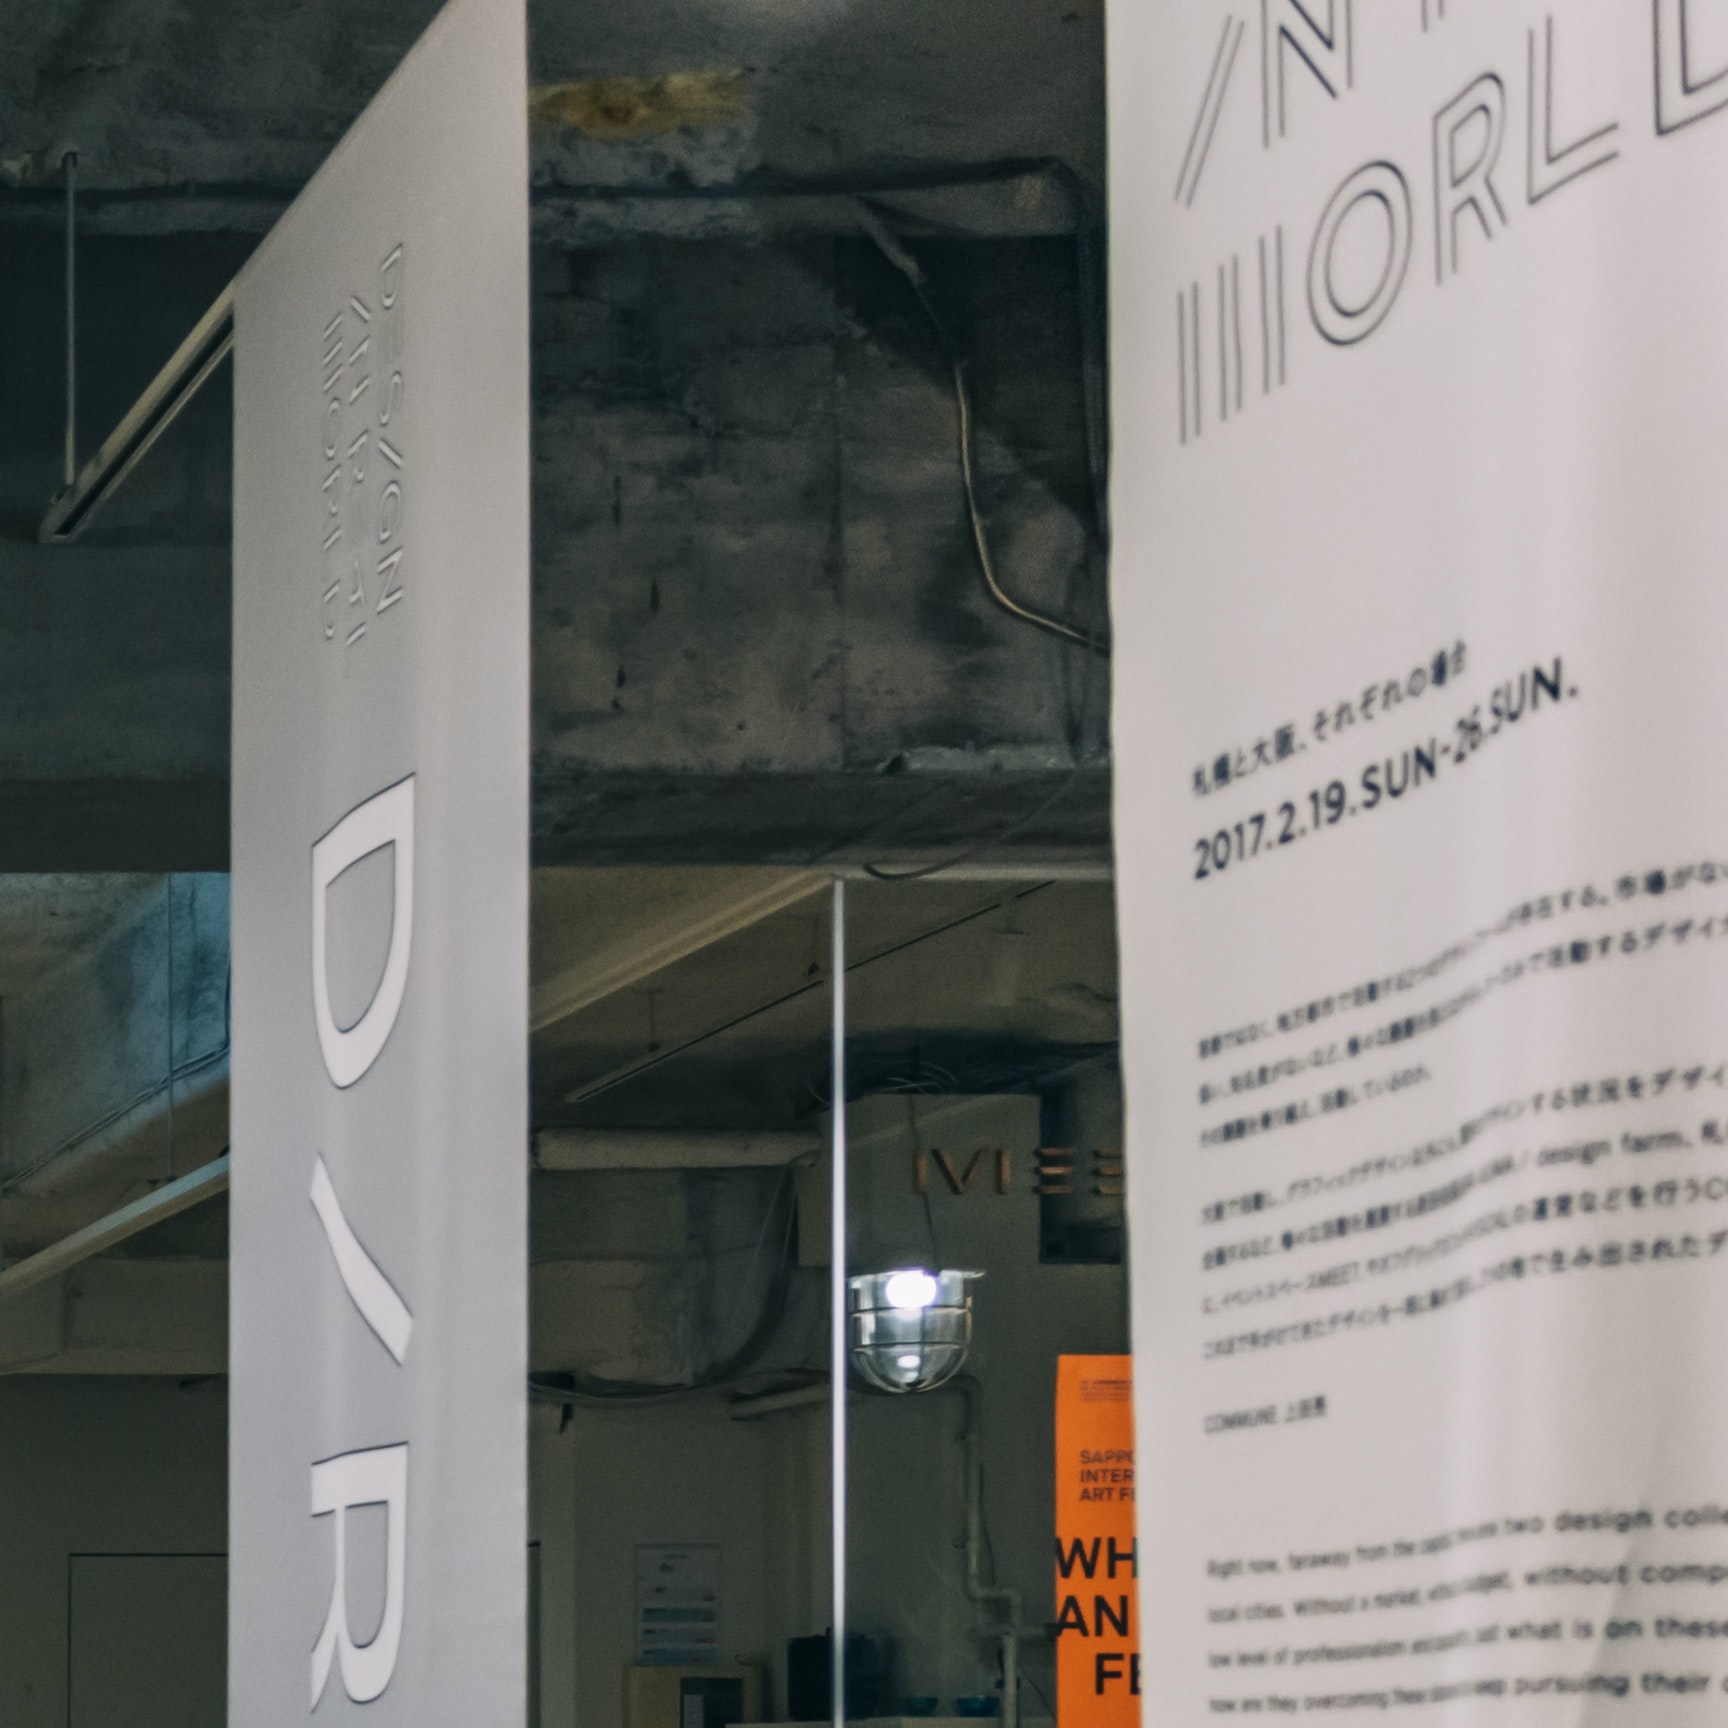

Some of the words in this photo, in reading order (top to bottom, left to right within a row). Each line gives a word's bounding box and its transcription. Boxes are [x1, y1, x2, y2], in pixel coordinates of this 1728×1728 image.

[1080, 1486, 1114, 1501] ART
[1554, 1508, 1653, 1534] design
[1057, 1595, 1129, 1638] AN
